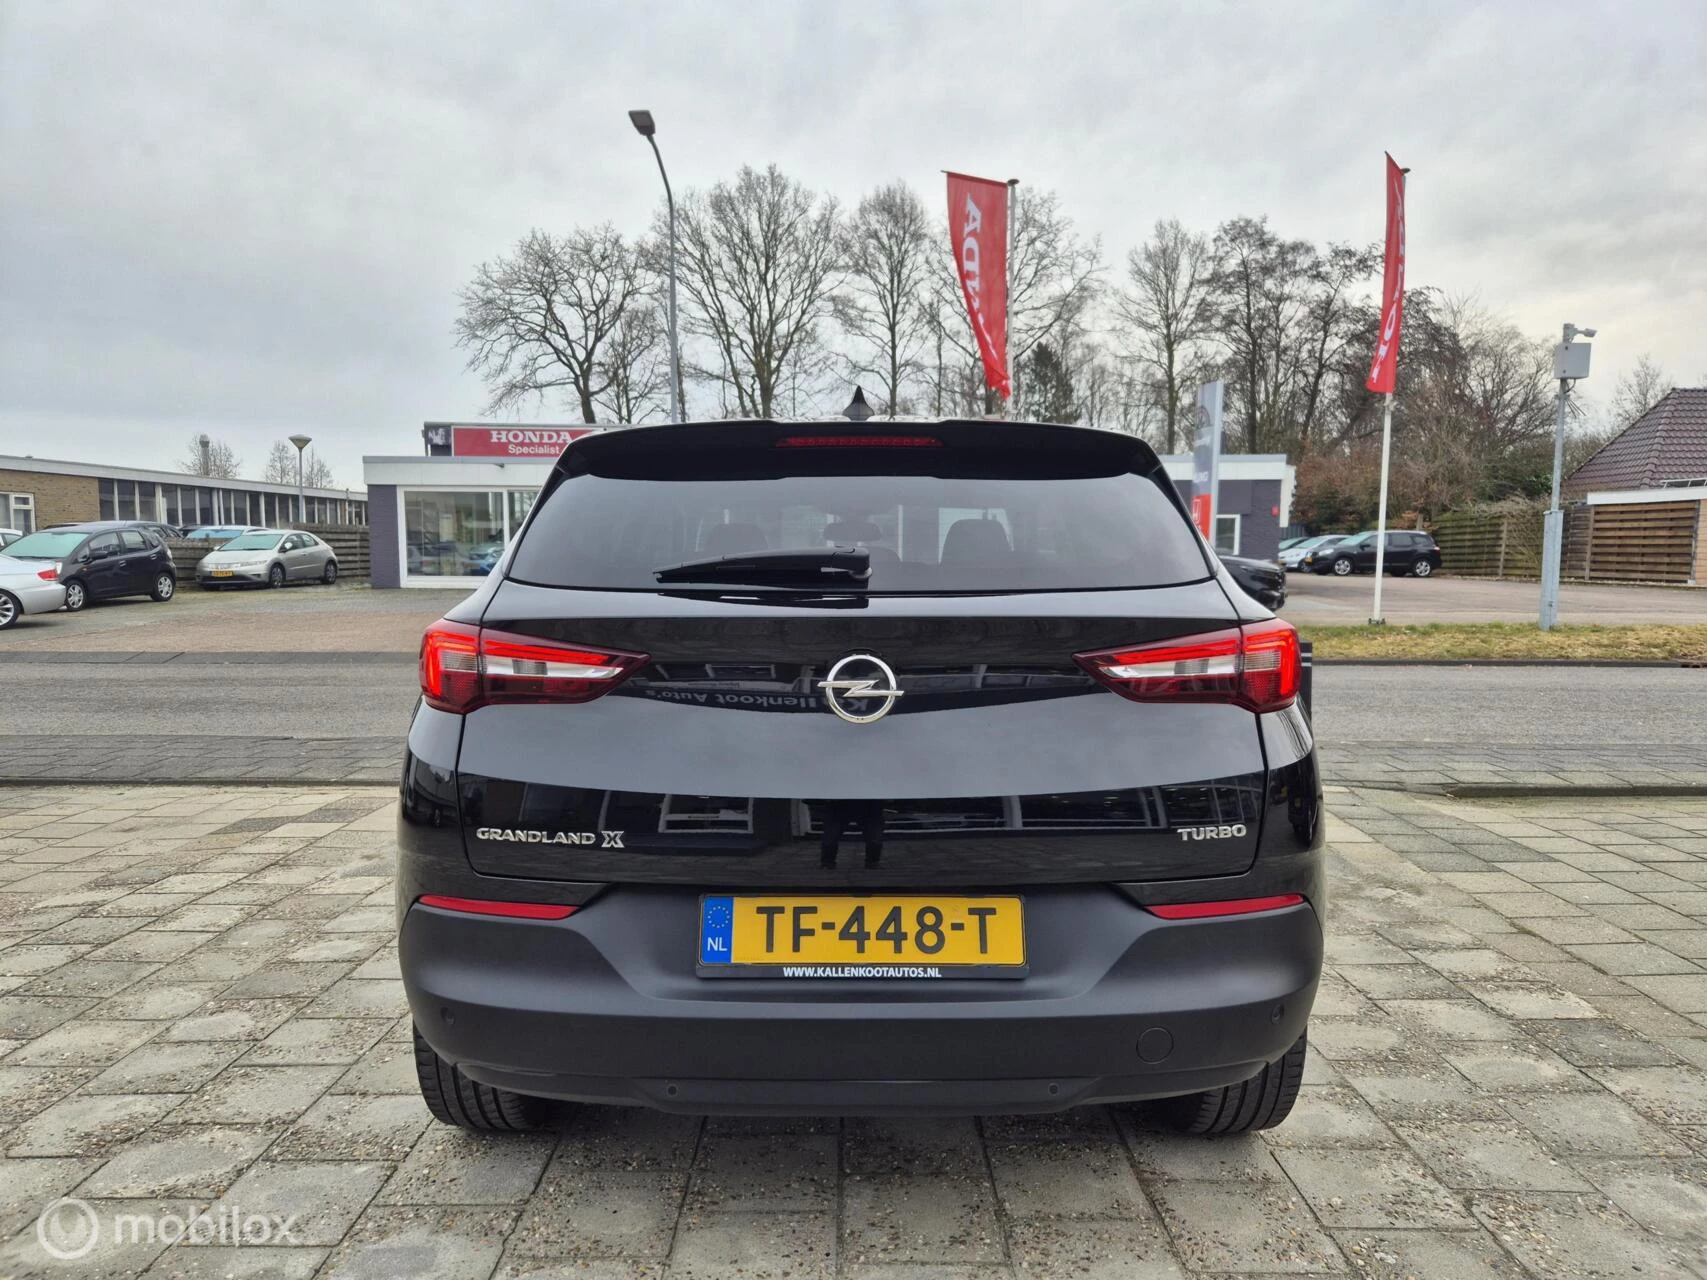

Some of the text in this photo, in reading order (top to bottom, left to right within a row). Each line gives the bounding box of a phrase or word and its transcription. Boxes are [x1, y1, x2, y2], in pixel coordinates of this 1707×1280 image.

[491, 430, 573, 443] HONDA
[508, 444, 560, 455] Specialist
[476, 827, 624, 848] GRANDLAND X
[1177, 824, 1247, 841] TURBO
[707, 905, 997, 954] NL TF-448-T
[783, 966, 942, 978] WWW.KALLENKOOTAUTOS.NL
